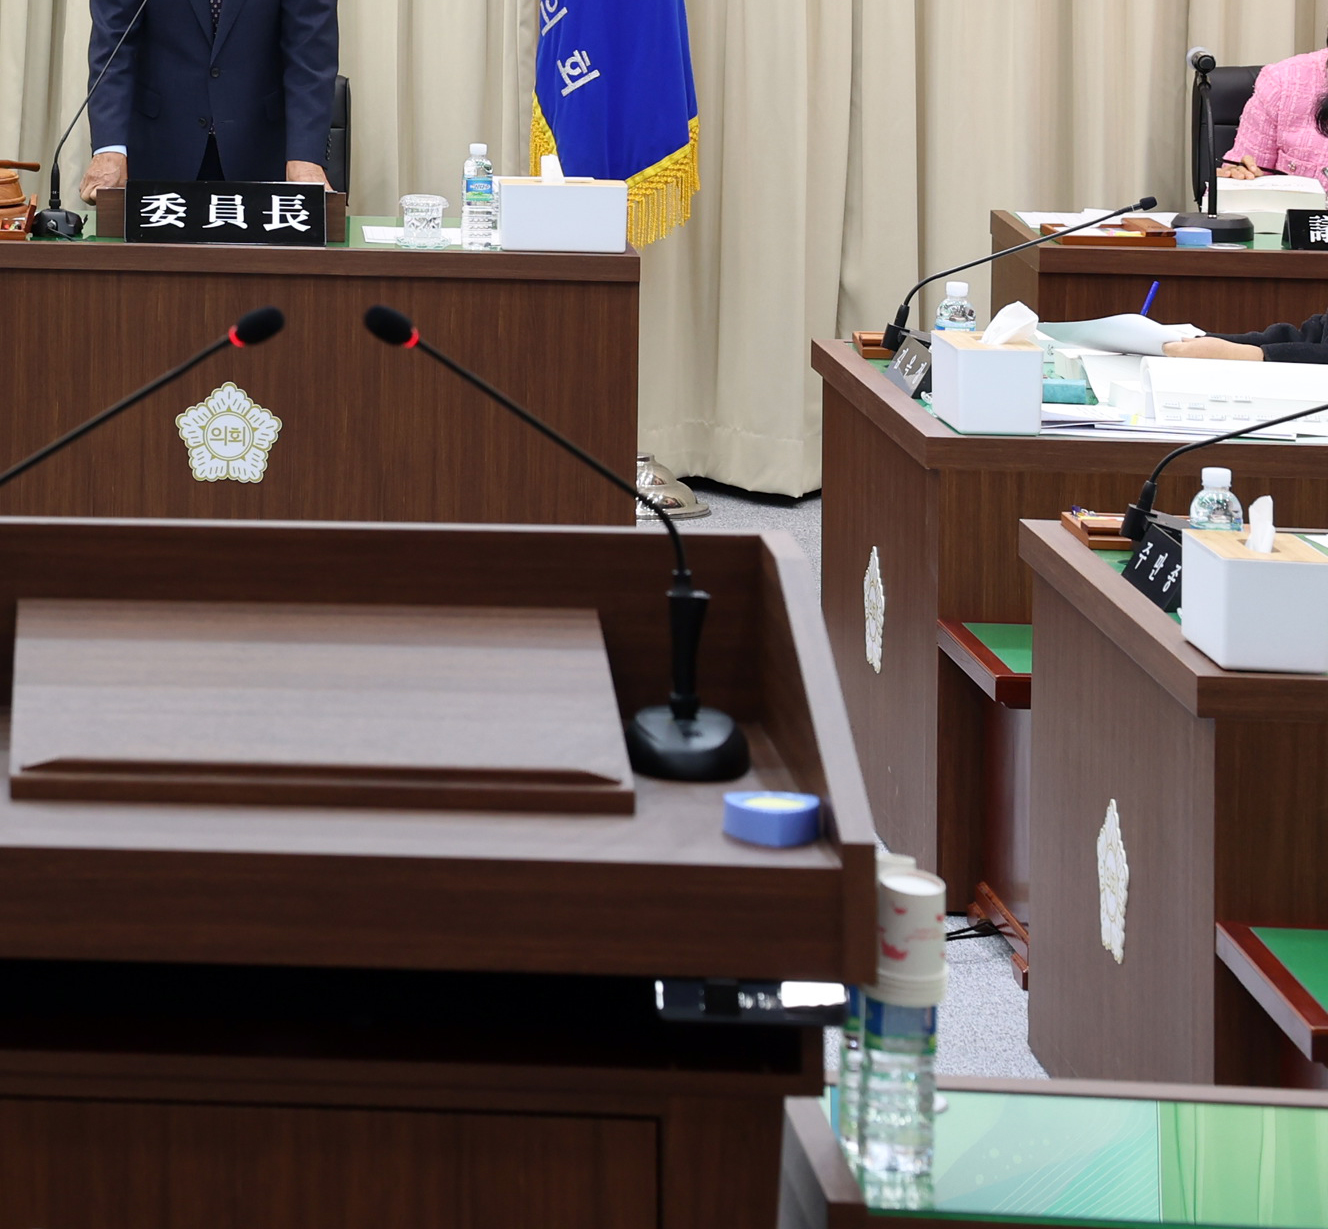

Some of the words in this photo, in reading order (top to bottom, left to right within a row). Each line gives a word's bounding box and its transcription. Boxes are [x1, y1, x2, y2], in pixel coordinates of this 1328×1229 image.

[139, 192, 312, 232] 委員長
[209, 425, 246, 447] 의회
[1134, 541, 1182, 593] 주만종
